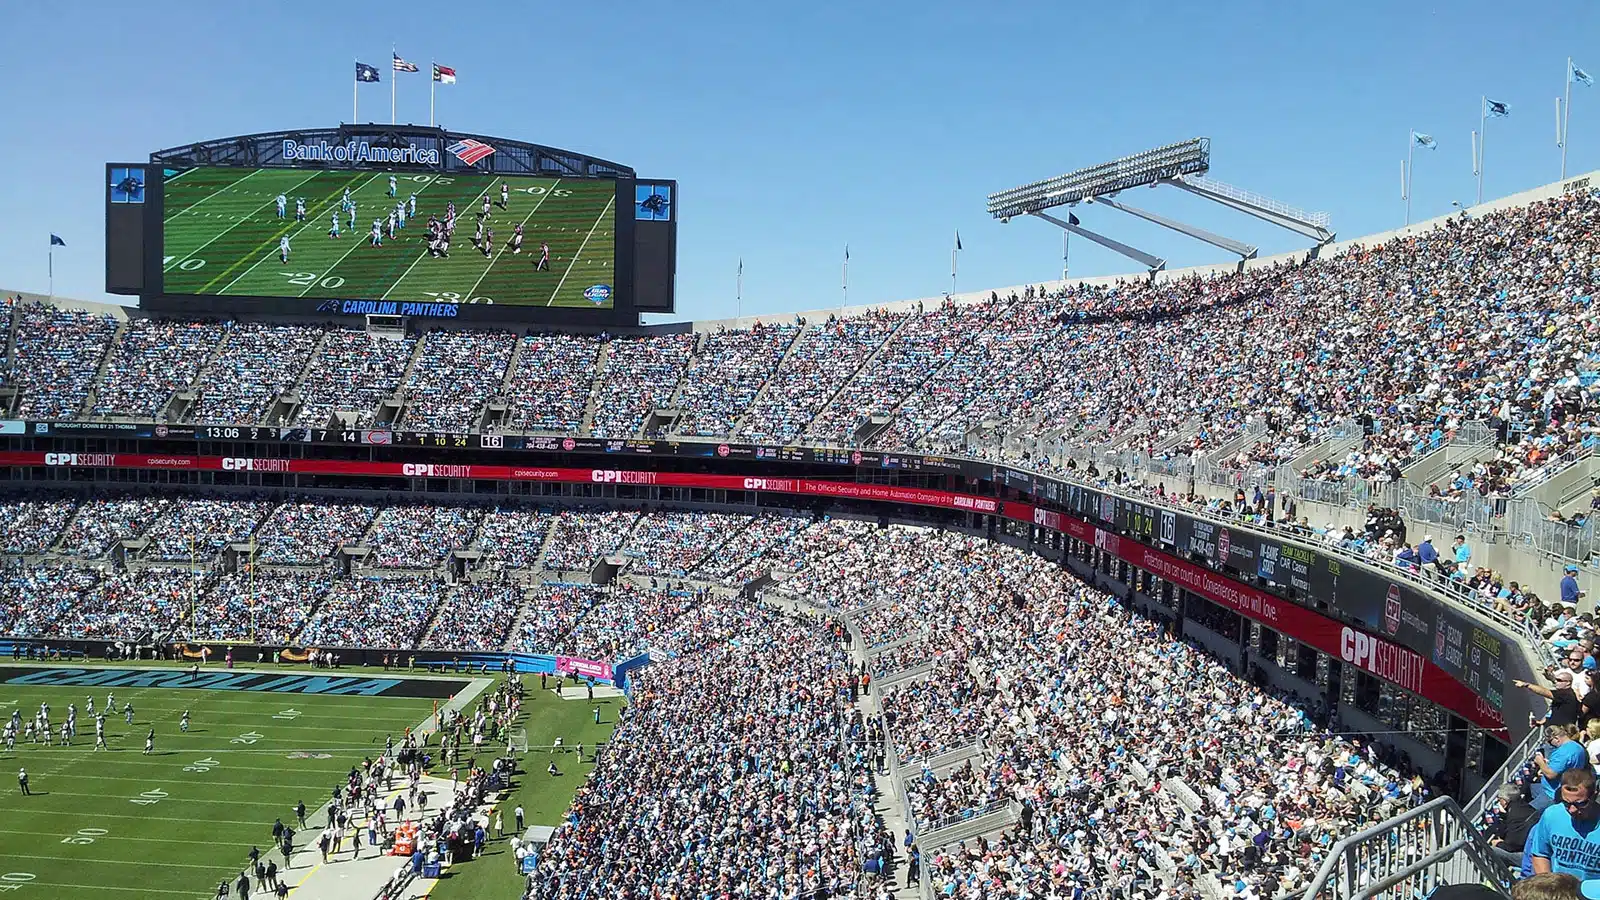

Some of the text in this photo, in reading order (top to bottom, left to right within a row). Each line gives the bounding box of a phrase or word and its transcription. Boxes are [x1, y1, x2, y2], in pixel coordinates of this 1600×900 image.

[282, 139, 439, 164] Bank of America
[342, 300, 458, 317] CAROLINA PANTHERS
[206, 427, 239, 438] 13:06
[251, 431, 258, 439] 2
[319, 431, 327, 441] 7
[341, 432, 355, 442] 14
[419, 437, 424, 445] 1
[436, 438, 446, 446] 10
[454, 438, 466, 447] 24
[483, 436, 499, 447] 16
[45, 453, 116, 466] CPI SECURITY
[147, 458, 191, 466] cpisecurity.com
[222, 457, 290, 472] CPI SECURITY
[402, 463, 471, 477] CPI SECURITY
[514, 469, 559, 478] cpisecurity.com
[592, 469, 657, 484] CPI SECURITY
[744, 478, 792, 491] CPI SECURITY
[805, 483, 816, 491] The
[817, 483, 837, 492] Official
[838, 485, 859, 495] Security
[872, 488, 889, 497] Home
[917, 493, 940, 503] Company
[1034, 507, 1046, 526] CPI
[1162, 515, 1173, 540] 16
[1095, 527, 1107, 550] CPI
[1282, 544, 1293, 557] TEAM
[1280, 556, 1291, 570] CAR
[1163, 560, 1171, 576] you
[1172, 564, 1180, 578] can
[1180, 568, 1194, 585] count
[1202, 573, 1238, 604] Conveniences
[1238, 592, 1250, 610] you
[1251, 594, 1262, 614] will
[1263, 598, 1278, 622] love.
[1341, 626, 1377, 673] CPI
[1377, 640, 1425, 694] SECURITY
[1471, 646, 1480, 666] GB
[5, 669, 402, 696] CAROLINA
[1469, 669, 1480, 692] ATL
[60, 828, 109, 845] 50
